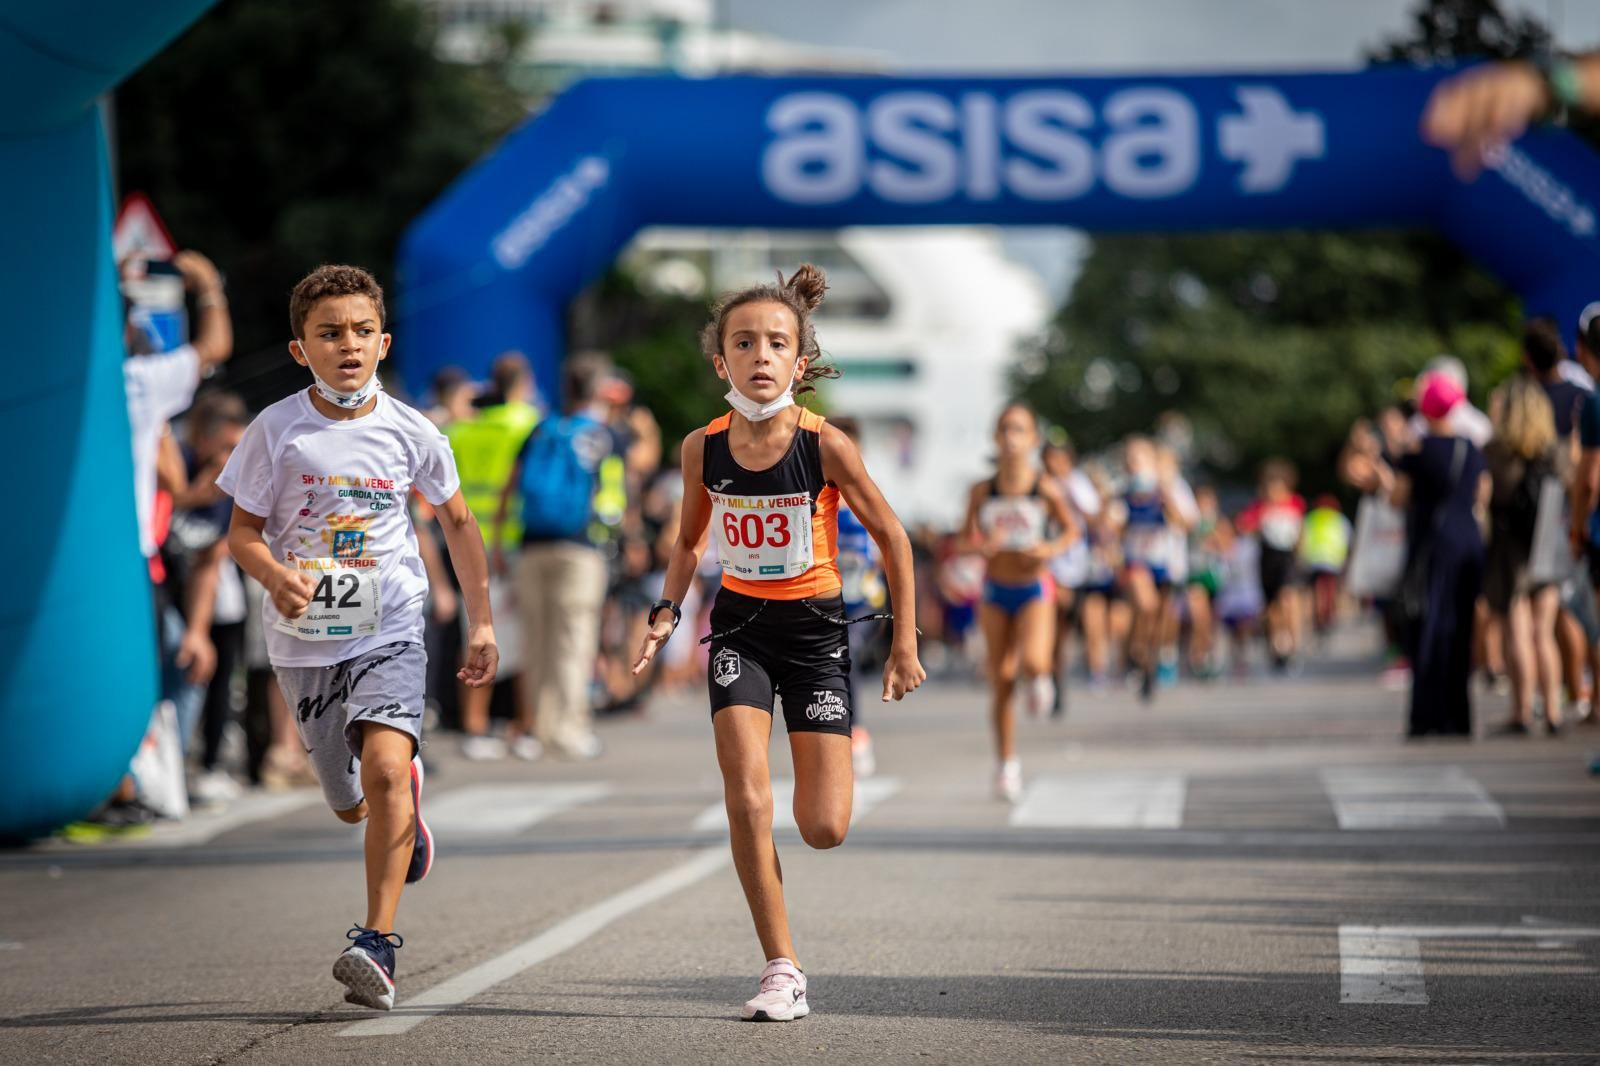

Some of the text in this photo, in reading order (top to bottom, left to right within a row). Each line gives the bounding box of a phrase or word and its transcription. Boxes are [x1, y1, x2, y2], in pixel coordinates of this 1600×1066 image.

[761, 88, 1200, 204] asisa
[319, 477, 325, 485] Y
[328, 476, 360, 487] MILLA
[365, 478, 394, 490] VERDE
[338, 490, 393, 500] GUARDIA CIVIL
[728, 498, 764, 509] MILLA
[768, 496, 806, 509] VERDE
[723, 512, 791, 549] 603
[300, 559, 377, 570] MILLA VERDE
